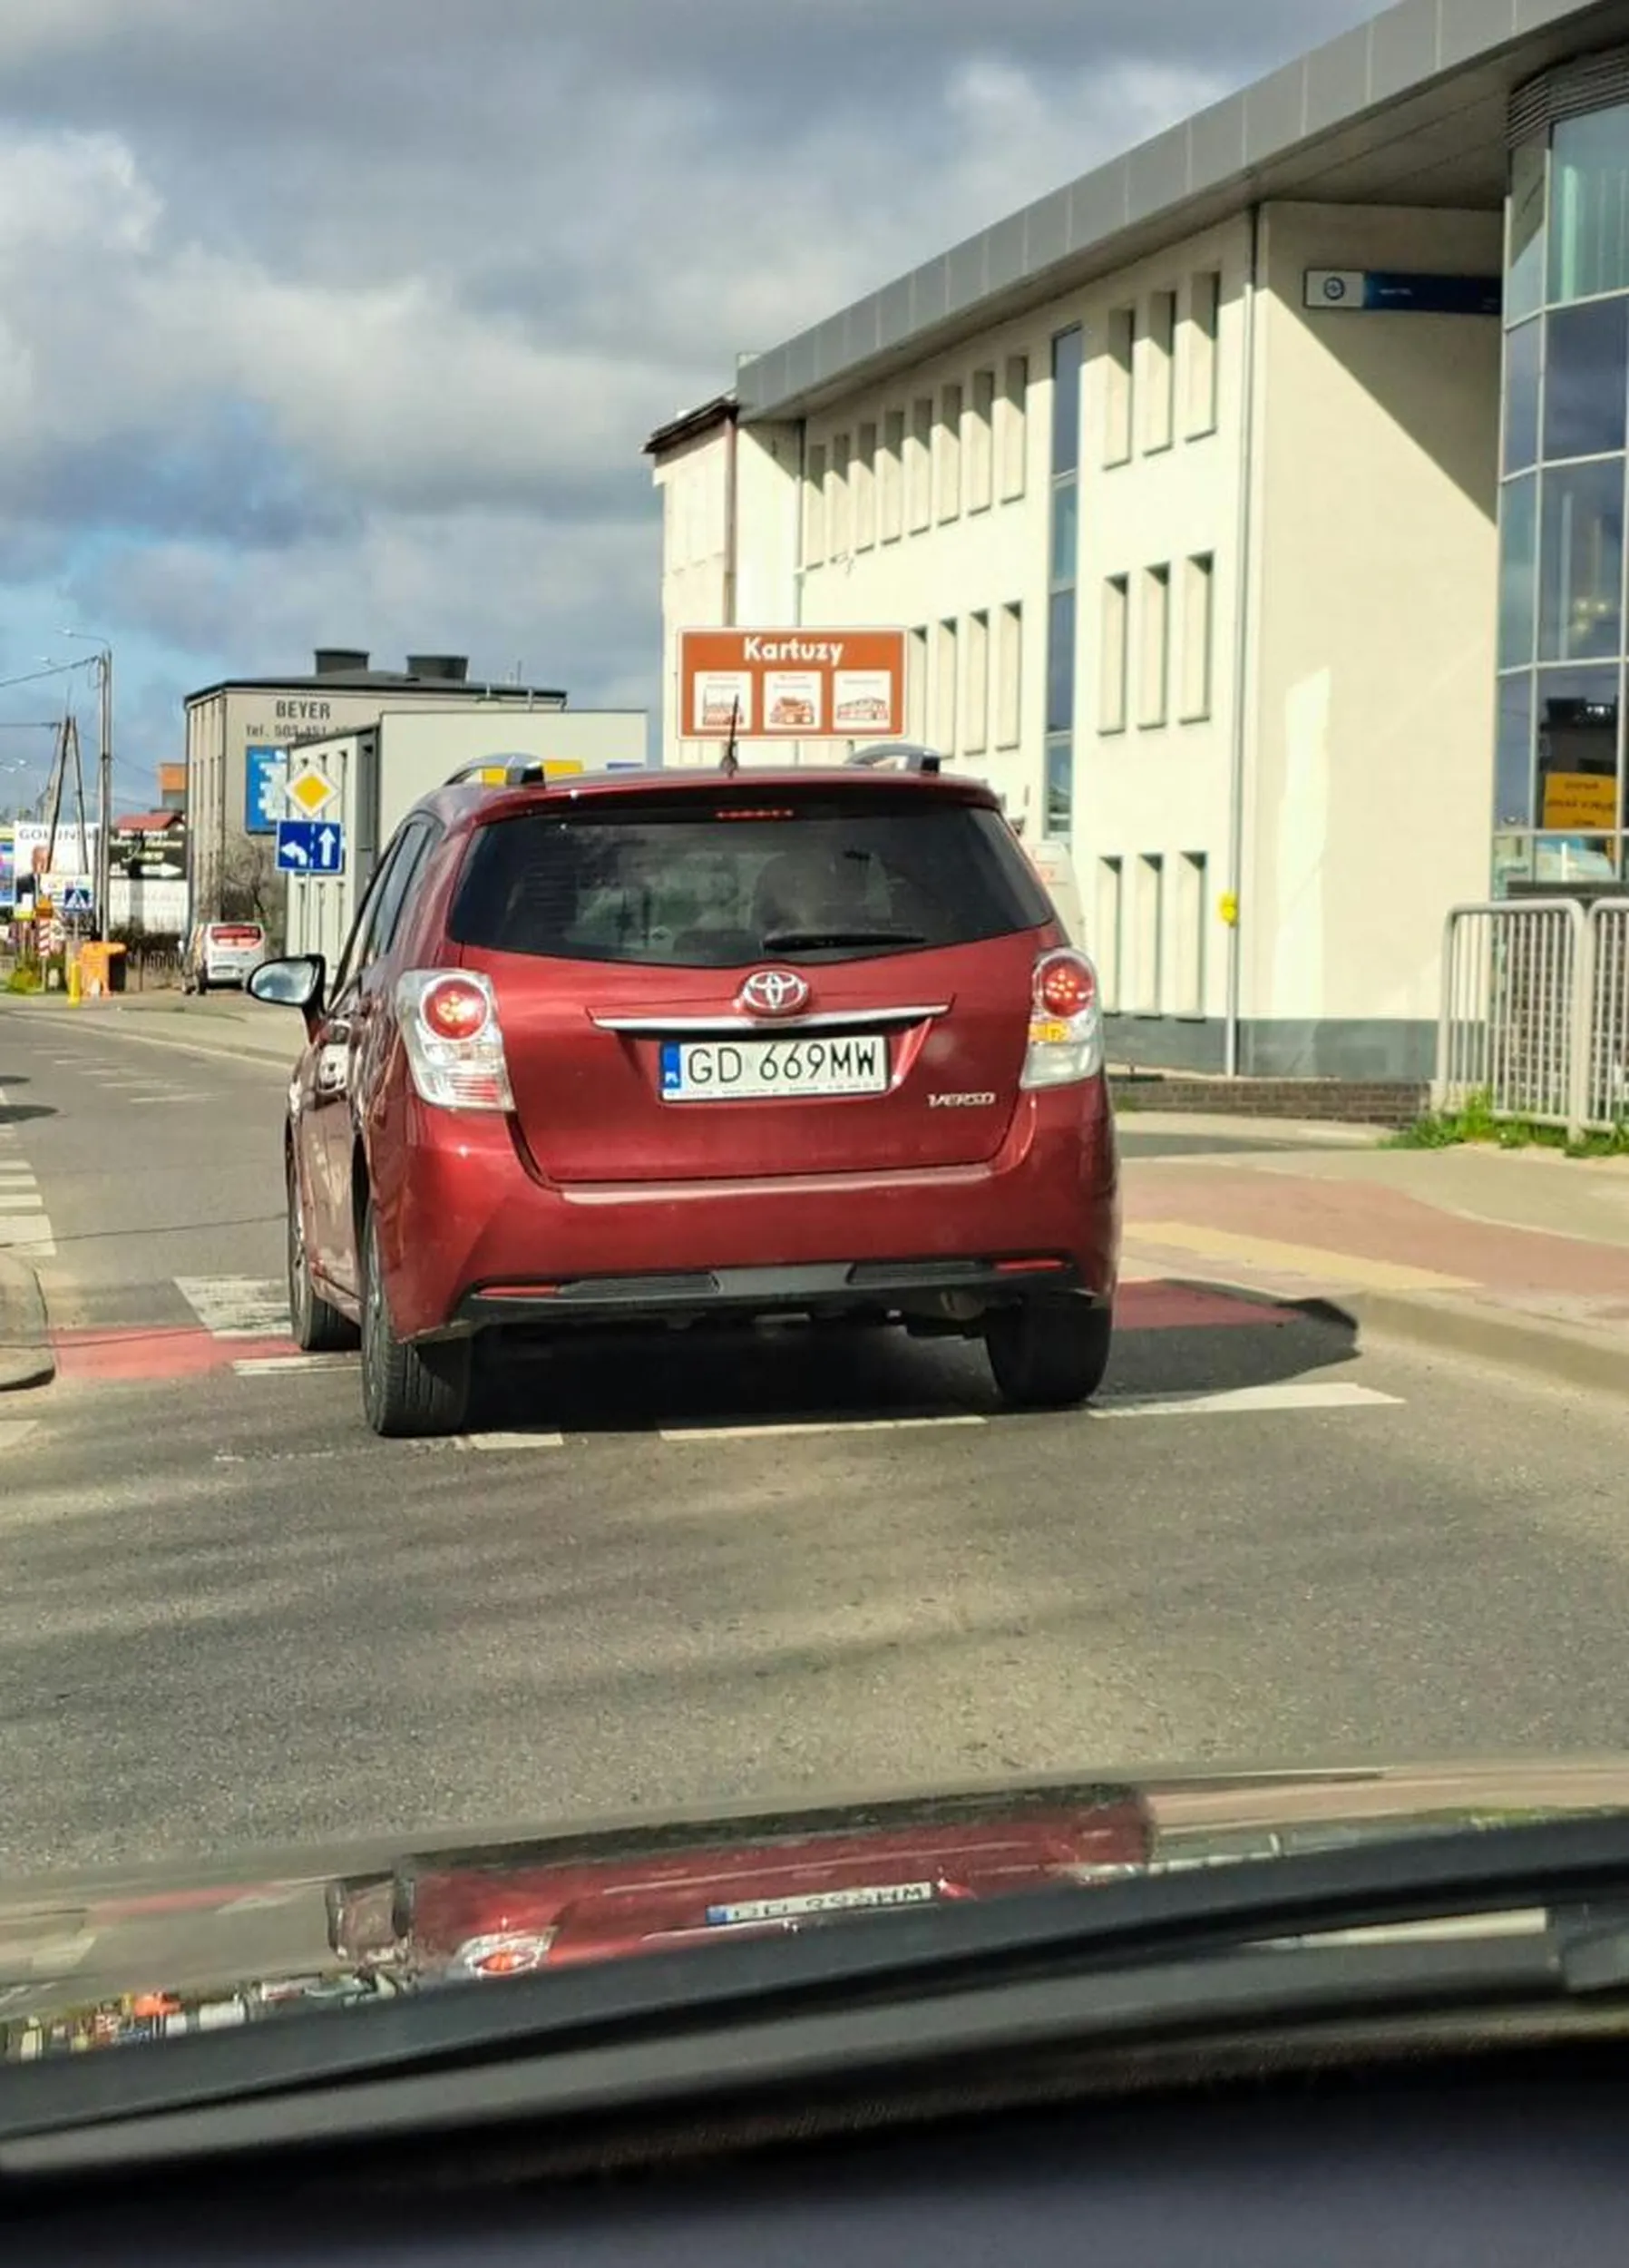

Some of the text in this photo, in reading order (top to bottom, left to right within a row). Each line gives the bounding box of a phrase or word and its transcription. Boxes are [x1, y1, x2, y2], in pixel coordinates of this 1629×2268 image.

[744, 636, 844, 666] Kartuzy
[275, 699, 331, 719] BEYER
[687, 1041, 877, 1084] GD 669MW
